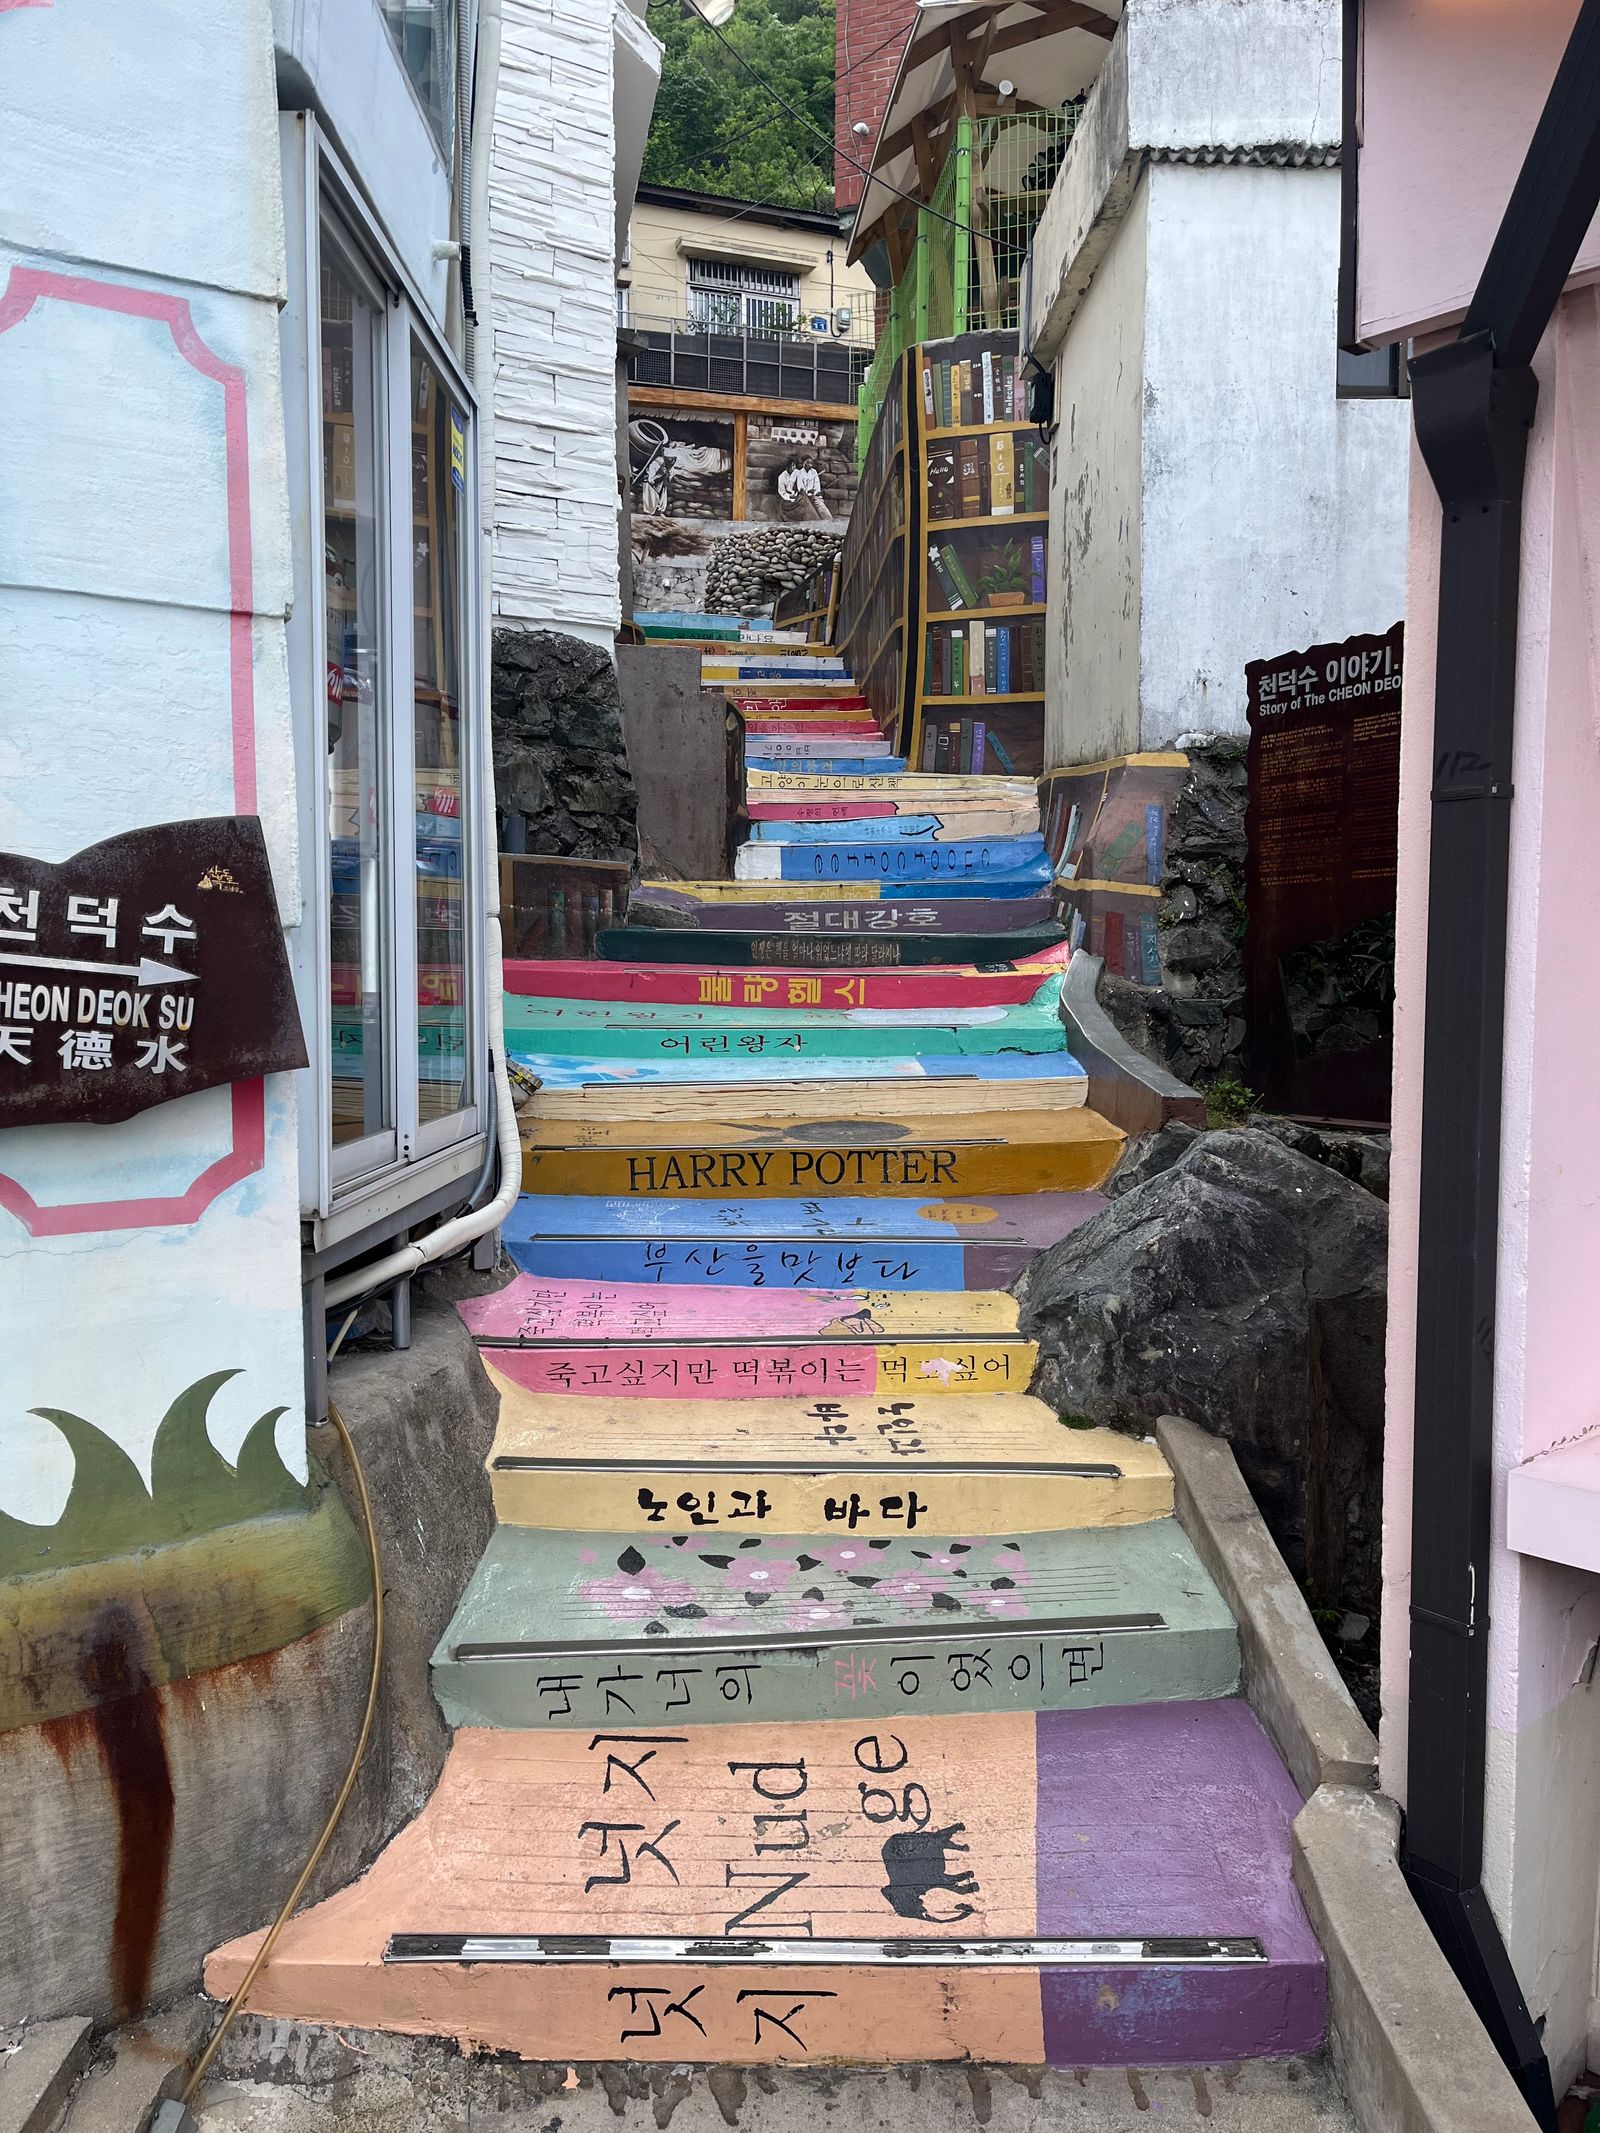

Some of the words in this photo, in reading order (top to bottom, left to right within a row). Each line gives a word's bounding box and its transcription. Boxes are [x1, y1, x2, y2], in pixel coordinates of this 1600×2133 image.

[1258, 665, 1319, 702] 천덕수
[1259, 701, 1288, 717] Story
[1290, 697, 1302, 710] of
[1304, 693, 1326, 708] The
[1328, 681, 1372, 702] CHEON
[783, 907, 942, 931] 절대강호
[791, 940, 814, 961] 얼마나
[698, 974, 866, 1005] 불량헬스
[77, 988, 151, 1029] DEOK
[158, 994, 195, 1031] SU
[660, 1034, 809, 1055] 어린왕자
[626, 1153, 774, 1191] HARRY
[789, 1150, 959, 1186] POTTER
[545, 1358, 718, 1387] 죽고싶지만
[732, 1356, 866, 1385] 떡볶이는
[637, 1488, 772, 1525] 노인과
[823, 1491, 928, 1529] 바다
[577, 1734, 689, 1894] 넛지
